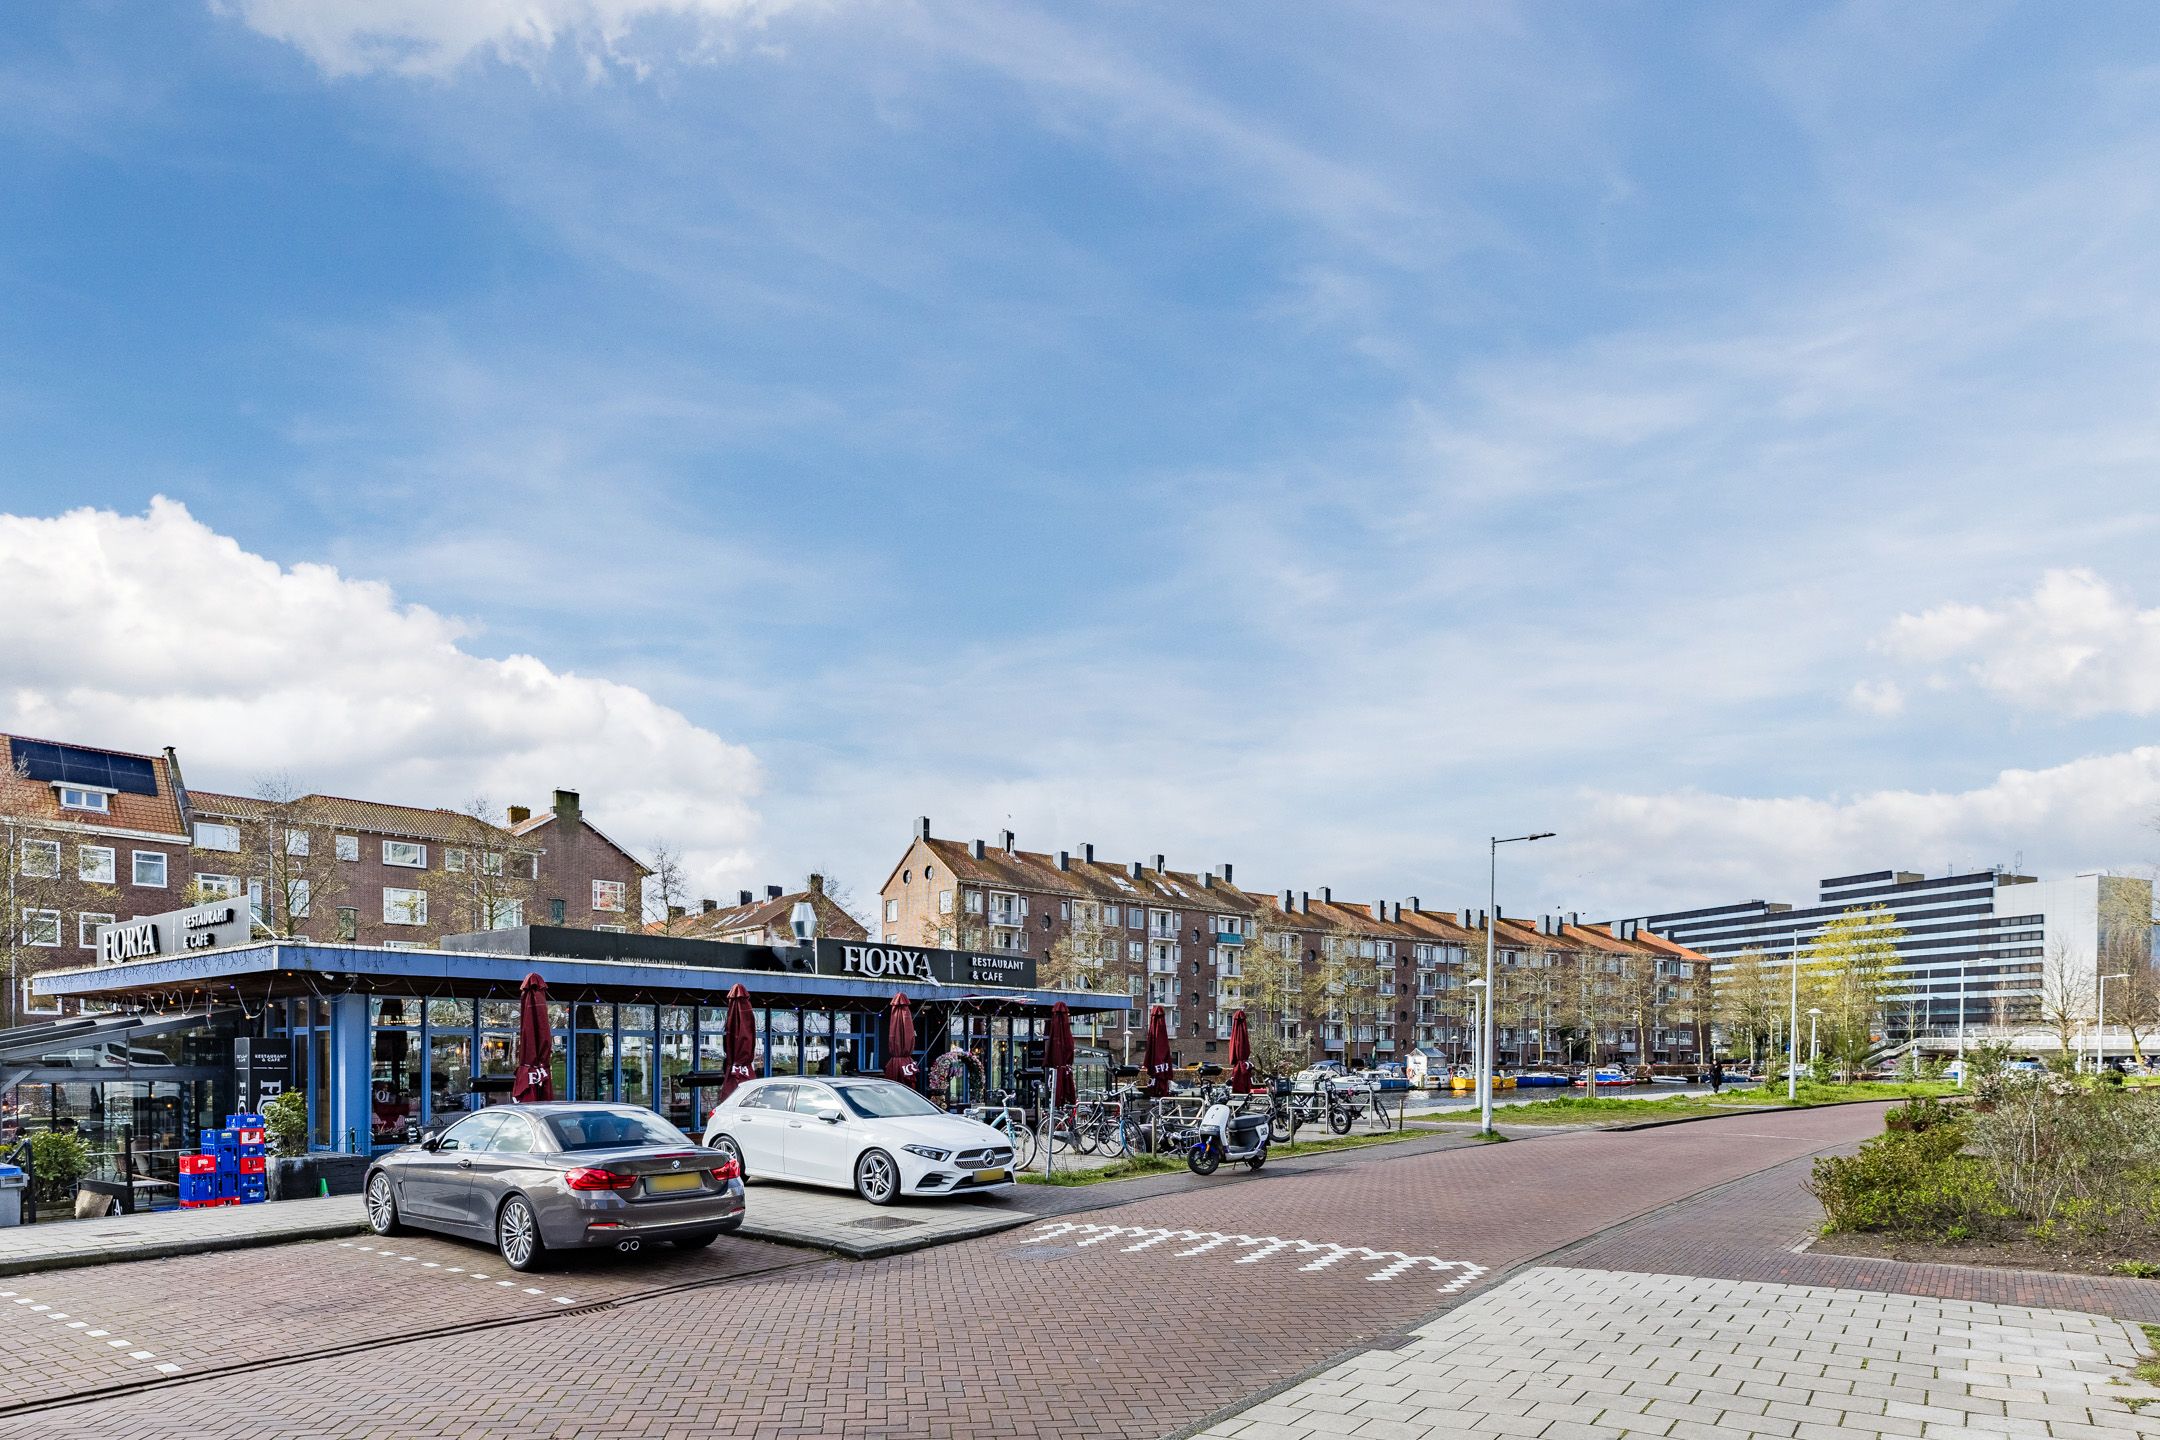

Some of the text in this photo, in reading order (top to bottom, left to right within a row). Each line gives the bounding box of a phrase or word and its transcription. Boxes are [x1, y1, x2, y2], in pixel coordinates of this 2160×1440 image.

[183, 907, 229, 929] RESTAURANT
[103, 923, 157, 963] FLORYA
[183, 932, 210, 949] & CAFE
[843, 946, 941, 987] FLORYA
[972, 956, 1024, 971] RESTAURANT
[972, 970, 1003, 982] & CAFE
